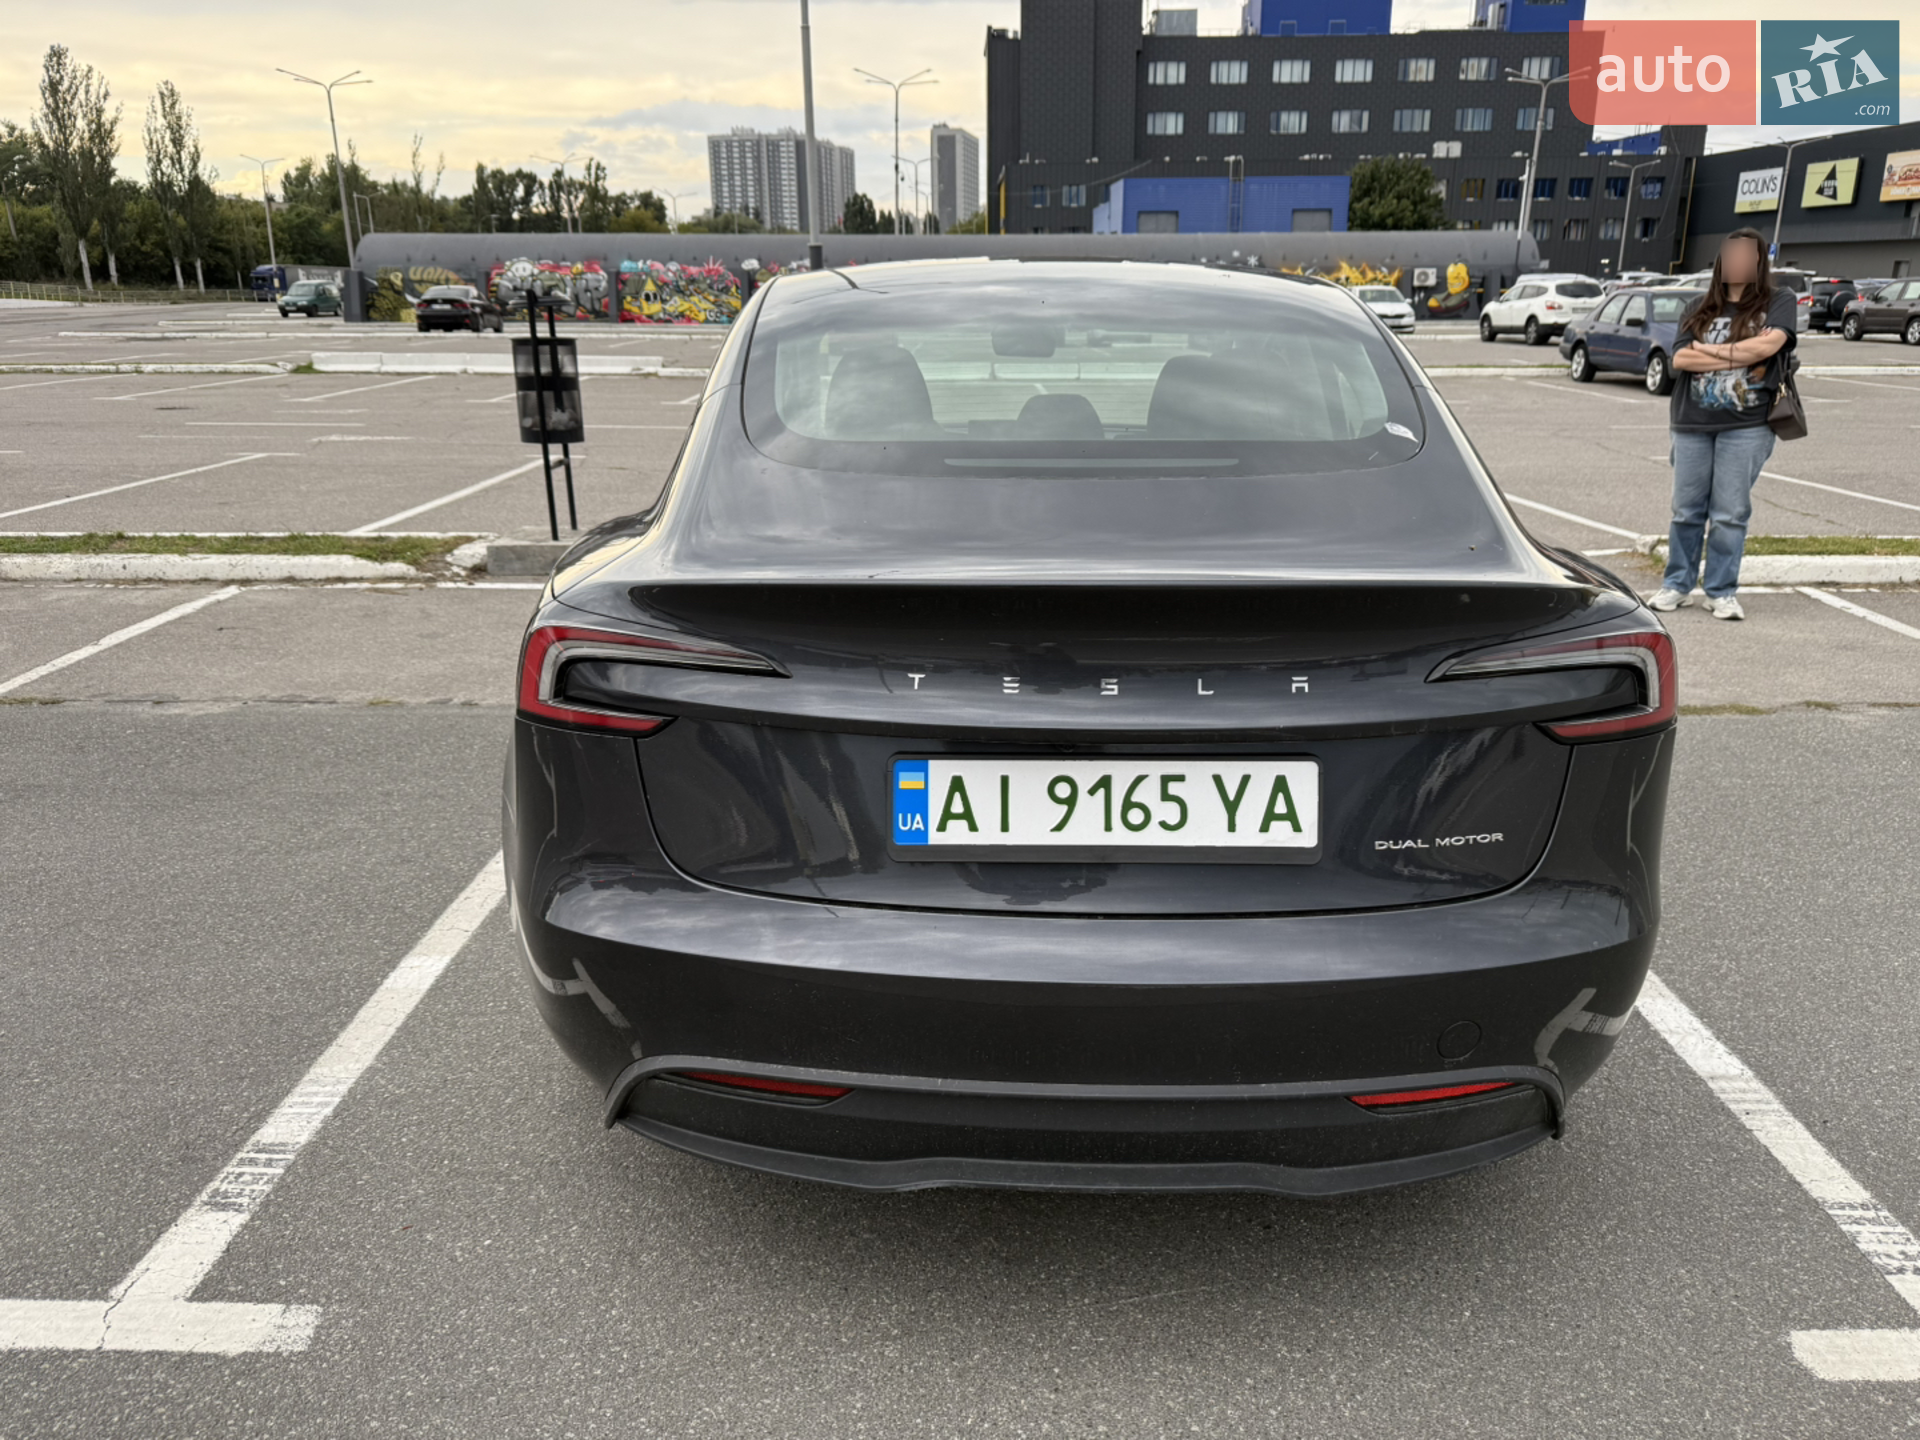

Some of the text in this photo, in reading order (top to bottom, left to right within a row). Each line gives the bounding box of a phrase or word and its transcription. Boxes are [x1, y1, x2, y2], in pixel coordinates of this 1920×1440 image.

[1741, 175, 1777, 195] COLIN'S
[907, 673, 1309, 696] TESLA
[935, 774, 1303, 833] AI 9165 YA
[898, 813, 925, 832] UA
[1374, 832, 1504, 850] DUAL MOTOR
